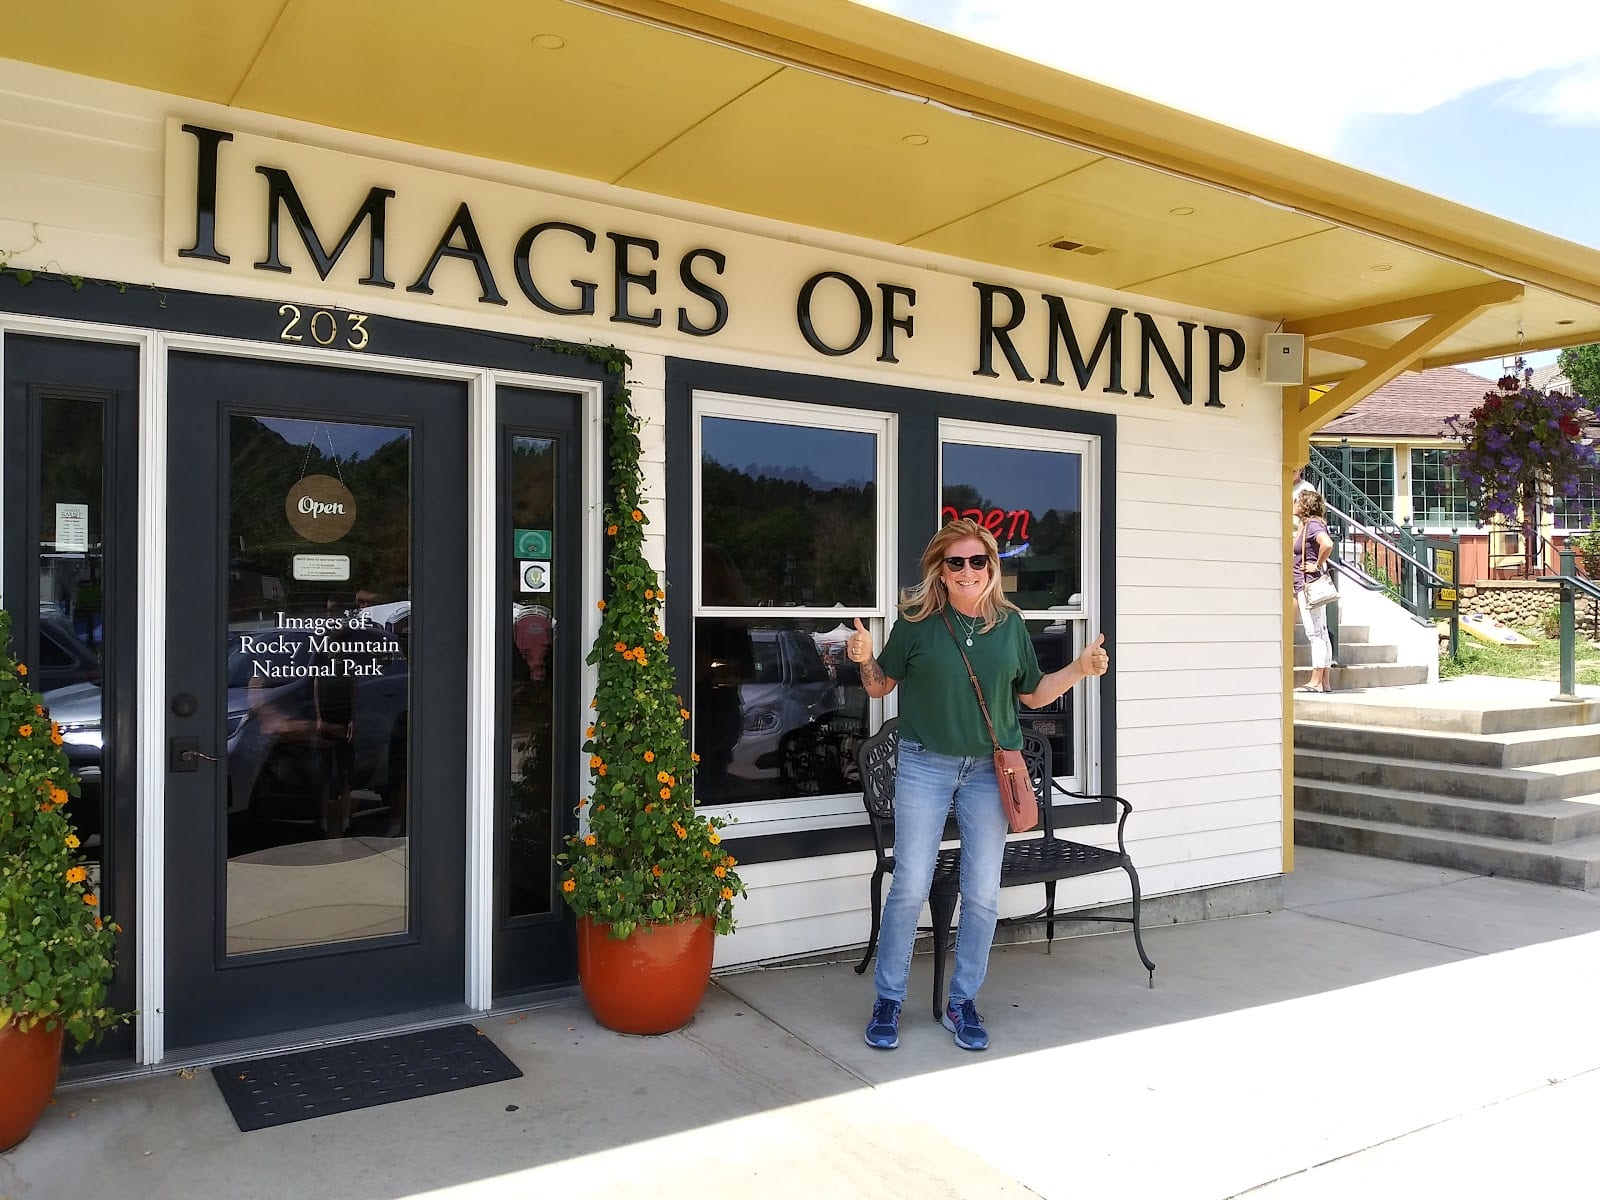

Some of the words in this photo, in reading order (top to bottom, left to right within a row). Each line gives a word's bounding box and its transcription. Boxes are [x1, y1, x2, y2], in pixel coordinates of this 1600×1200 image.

[178, 124, 729, 337] IMAGES
[796, 271, 916, 364] OF
[972, 281, 1246, 409] RMNP
[279, 304, 369, 350] 203
[298, 495, 346, 519] Open
[276, 611, 343, 635] Images
[348, 611, 371, 630] of
[239, 635, 302, 658] Rocky
[307, 635, 400, 654] Mountain
[252, 658, 336, 678] National
[342, 658, 383, 677] Park
